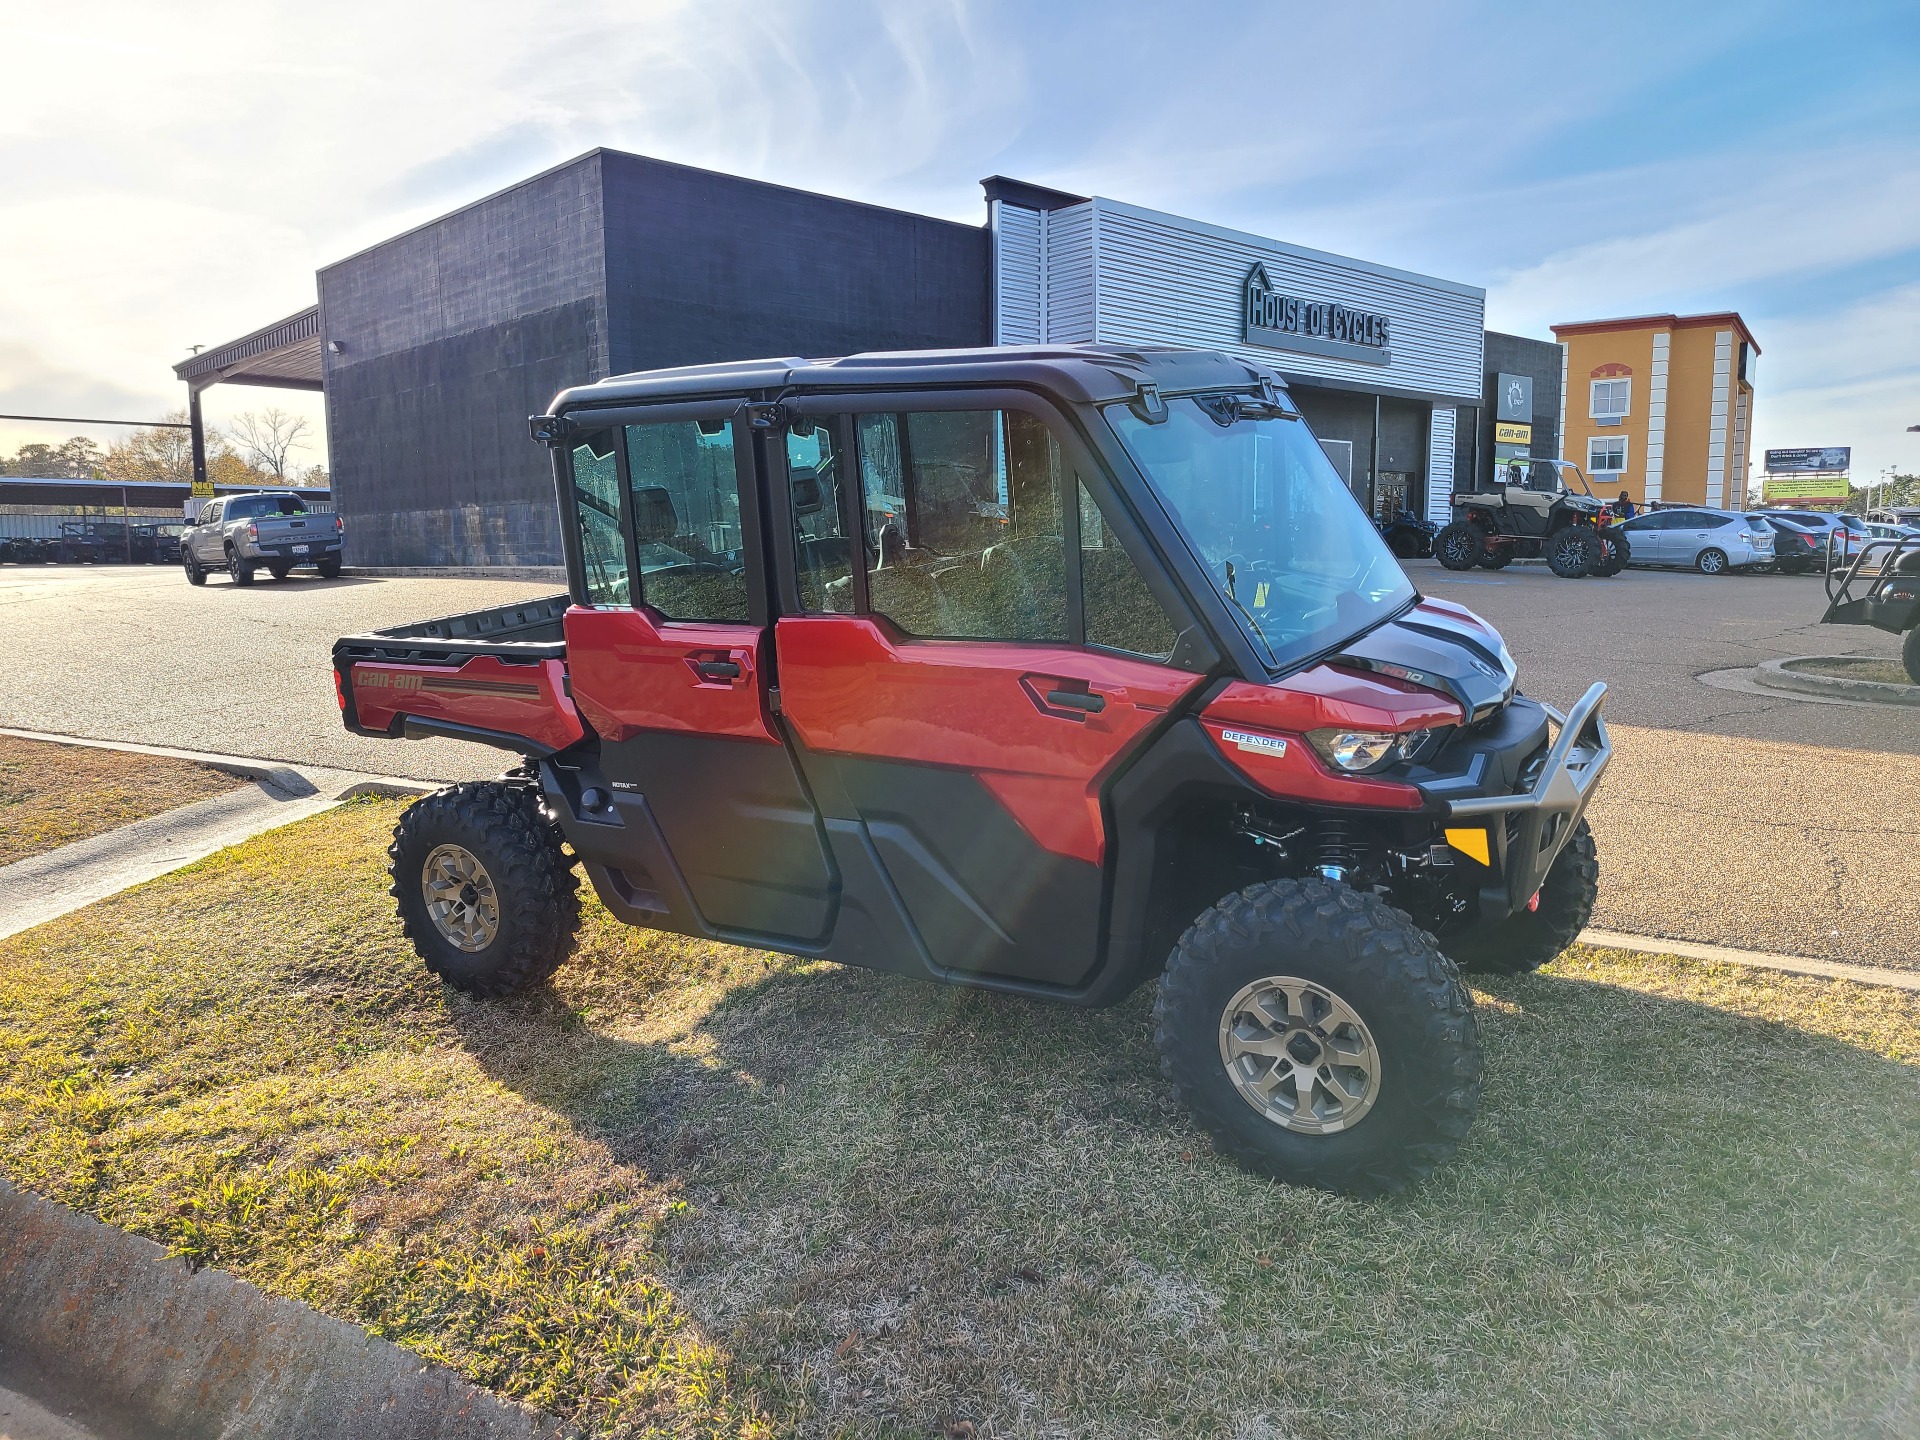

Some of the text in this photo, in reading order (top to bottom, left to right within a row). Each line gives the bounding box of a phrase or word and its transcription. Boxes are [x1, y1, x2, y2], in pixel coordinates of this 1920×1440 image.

[1251, 287, 1390, 347] HOUSE OF CYCLES
[1498, 428, 1529, 439] can-am
[357, 671, 423, 690] can-am
[1223, 731, 1285, 749] DEFENDER
[612, 781, 631, 789] ROTAX
